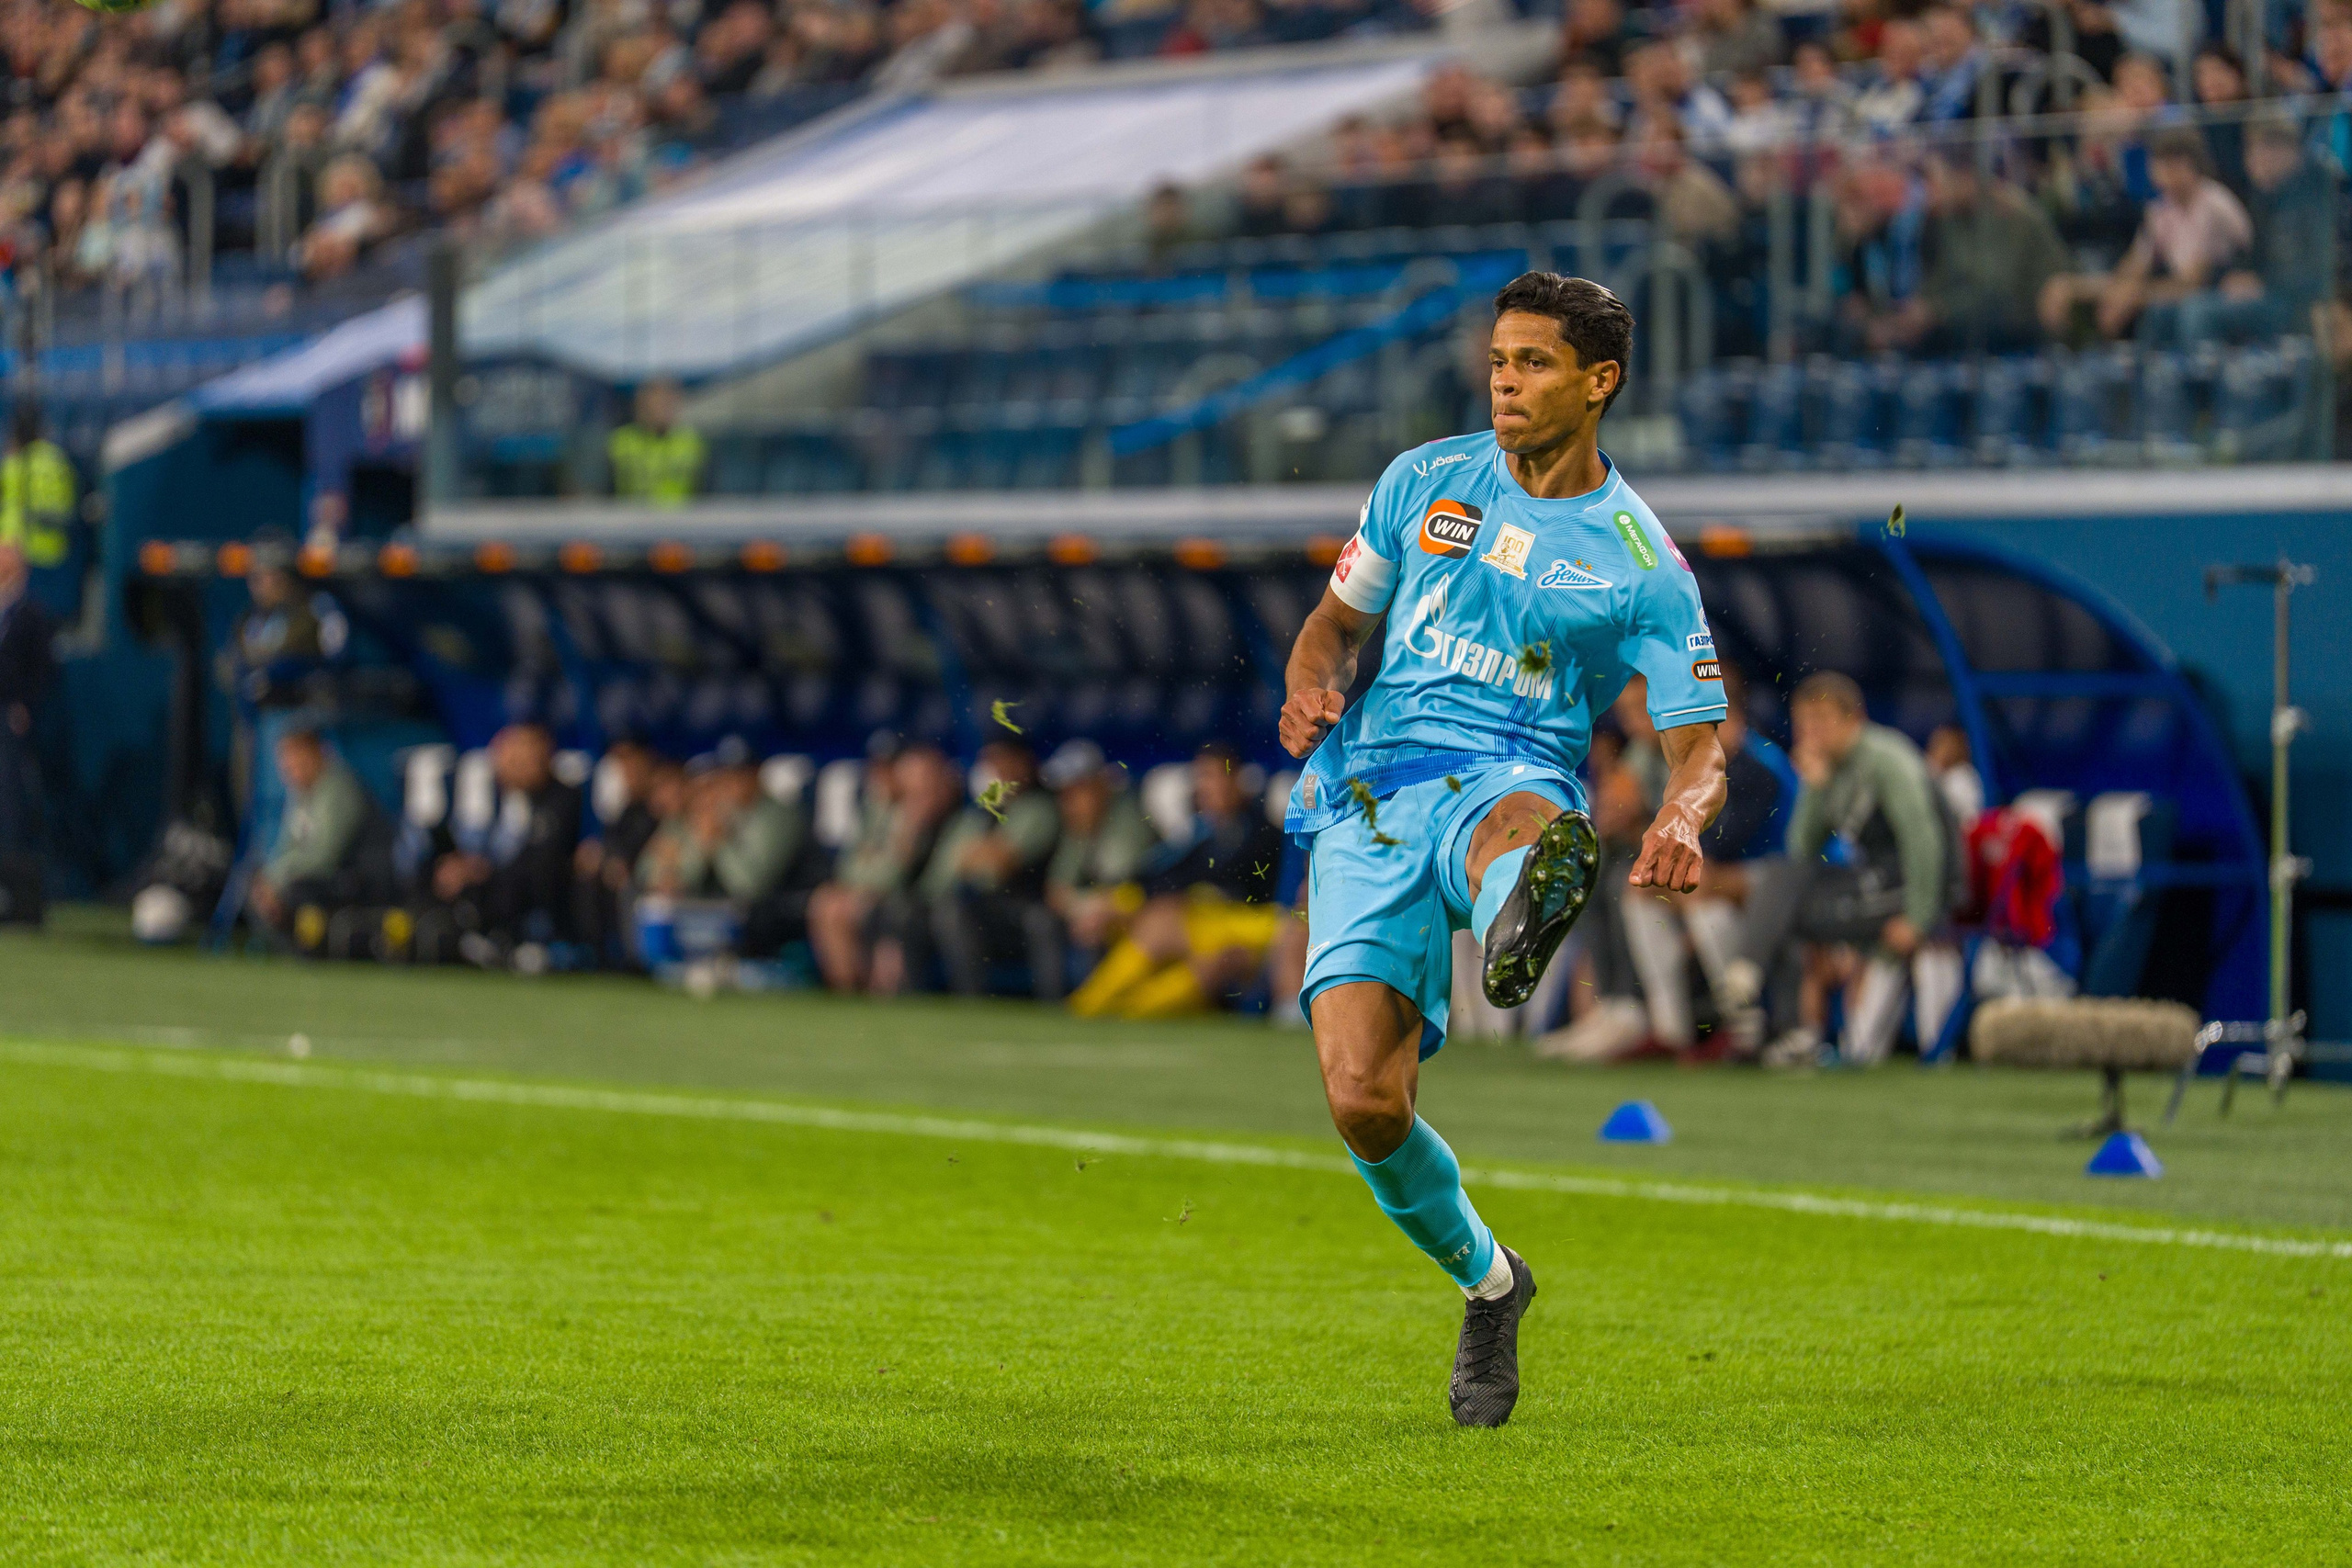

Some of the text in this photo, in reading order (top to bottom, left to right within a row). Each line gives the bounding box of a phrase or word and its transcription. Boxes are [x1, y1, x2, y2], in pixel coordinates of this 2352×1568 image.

[1430, 453, 1472, 470] JÖGEL
[1433, 518, 1475, 541] WIN
[1625, 525, 1654, 567] МЕГАФОН
[1440, 633, 1556, 700] ГАЗПРОМ
